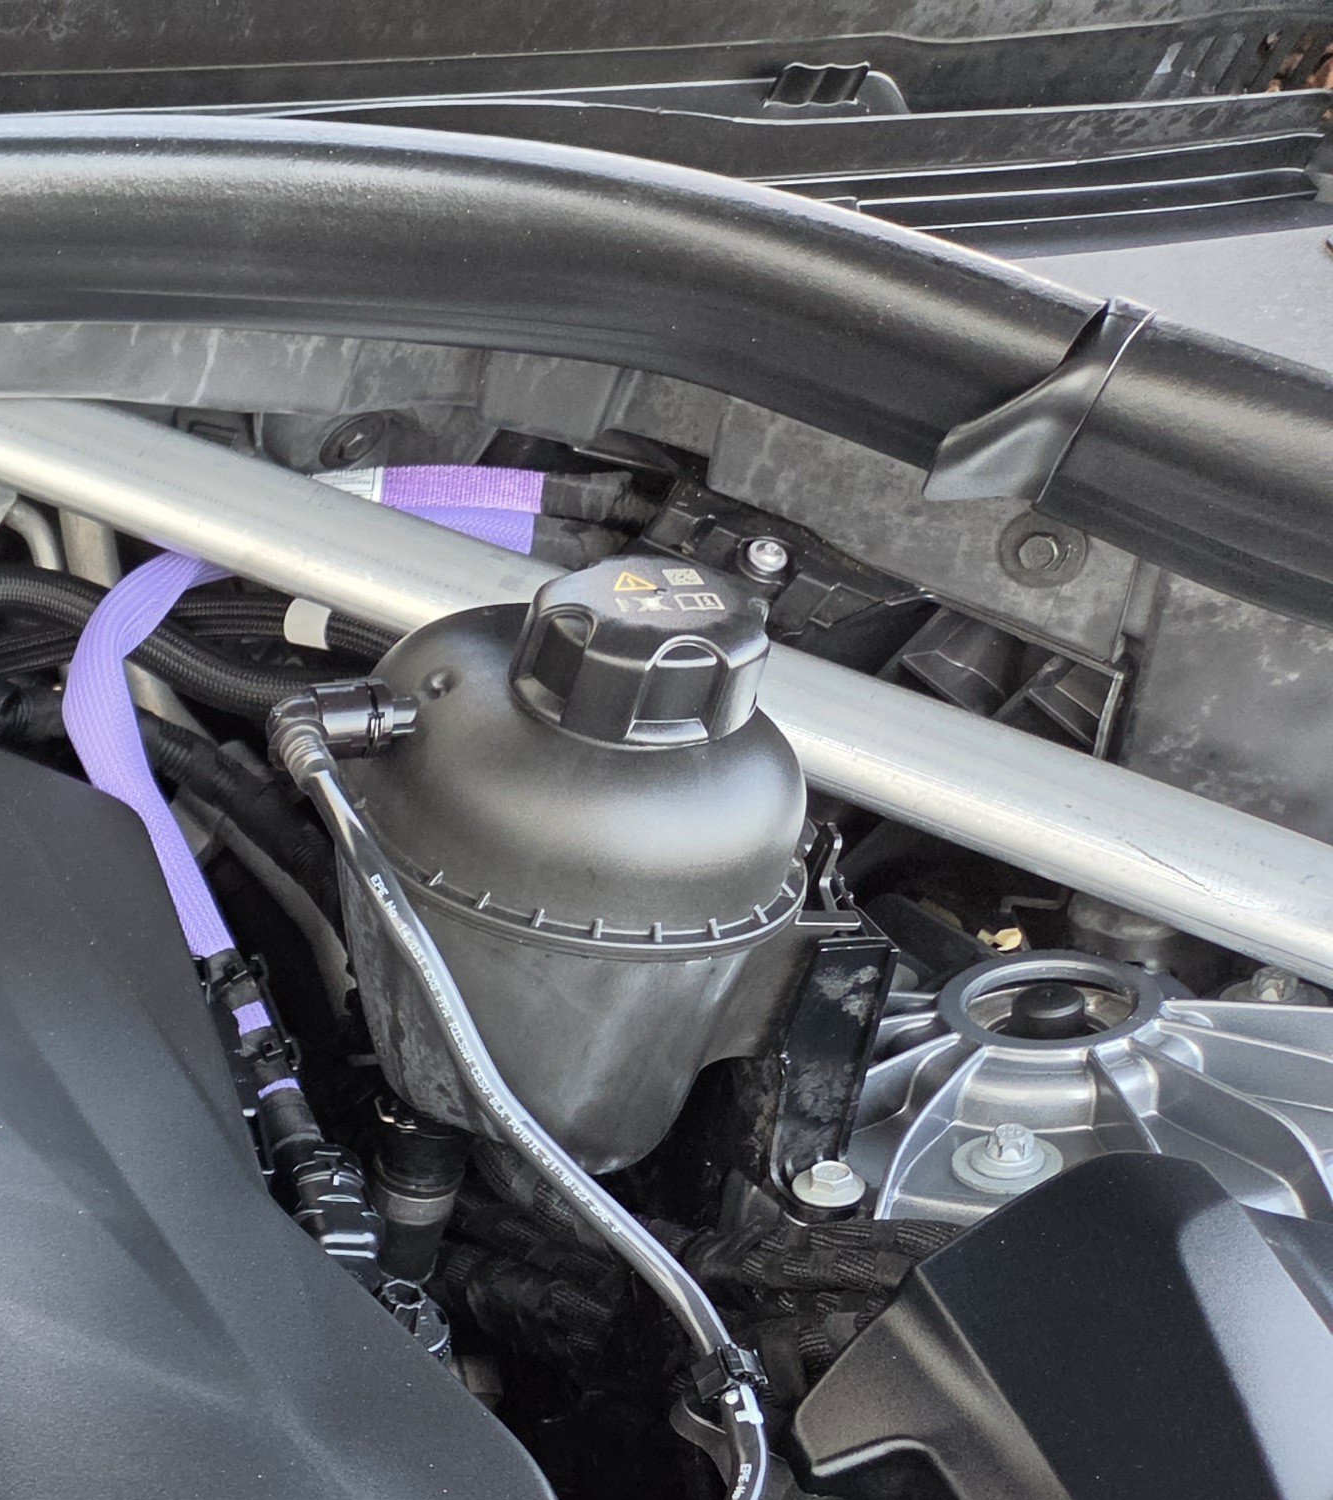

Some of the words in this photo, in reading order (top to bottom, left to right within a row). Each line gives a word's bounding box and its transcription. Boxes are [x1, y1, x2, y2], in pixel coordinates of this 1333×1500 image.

[370, 873, 390, 899] EPE
[384, 900, 399, 919] No
[436, 995, 453, 1018] PPA
[448, 1021, 476, 1064] RILSAN
[488, 1096, 508, 1119] BLK
[737, 1463, 753, 1484] EPE
